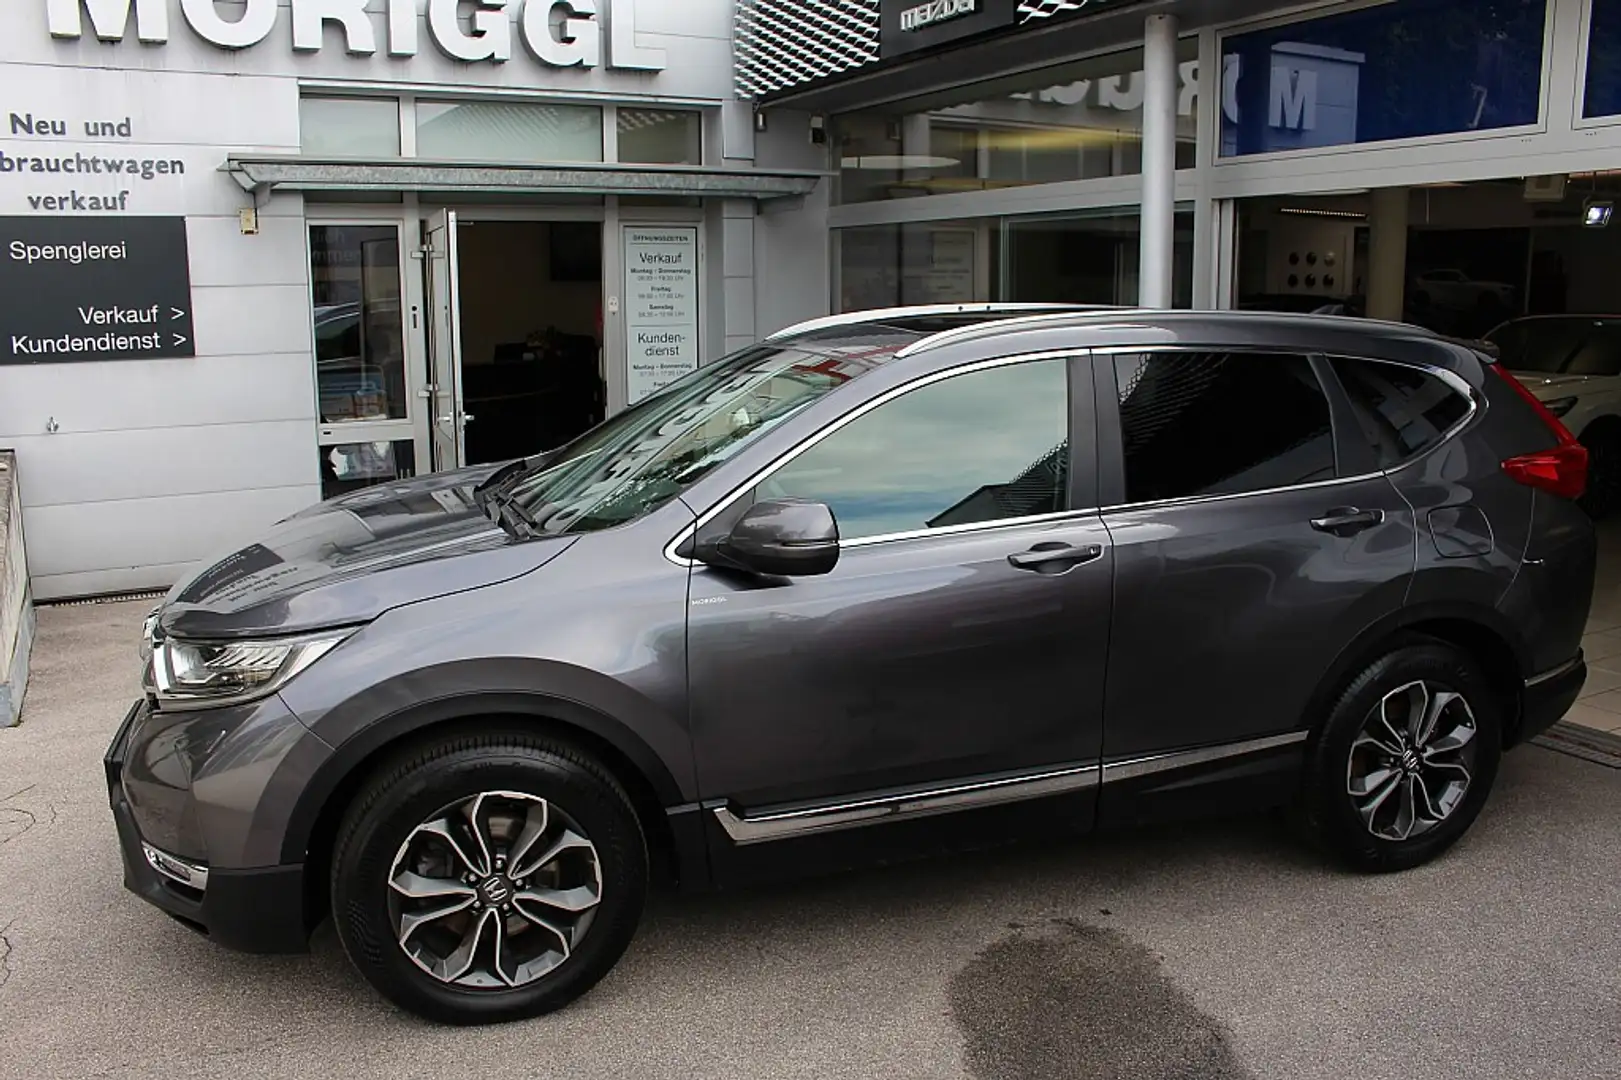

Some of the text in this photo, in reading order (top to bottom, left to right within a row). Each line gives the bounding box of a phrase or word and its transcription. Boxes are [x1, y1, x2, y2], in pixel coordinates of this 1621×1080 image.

[9, 113, 132, 137] Neu und
[0, 152, 185, 180] brauchtwagen
[27, 190, 130, 211] verkauf
[9, 240, 127, 264] Spenglerei
[639, 251, 682, 264] Verkauf
[78, 304, 159, 324] Verkauf
[11, 332, 161, 354] Kundendienst
[637, 332, 686, 344] Kunden-
[644, 345, 680, 357] dienst
